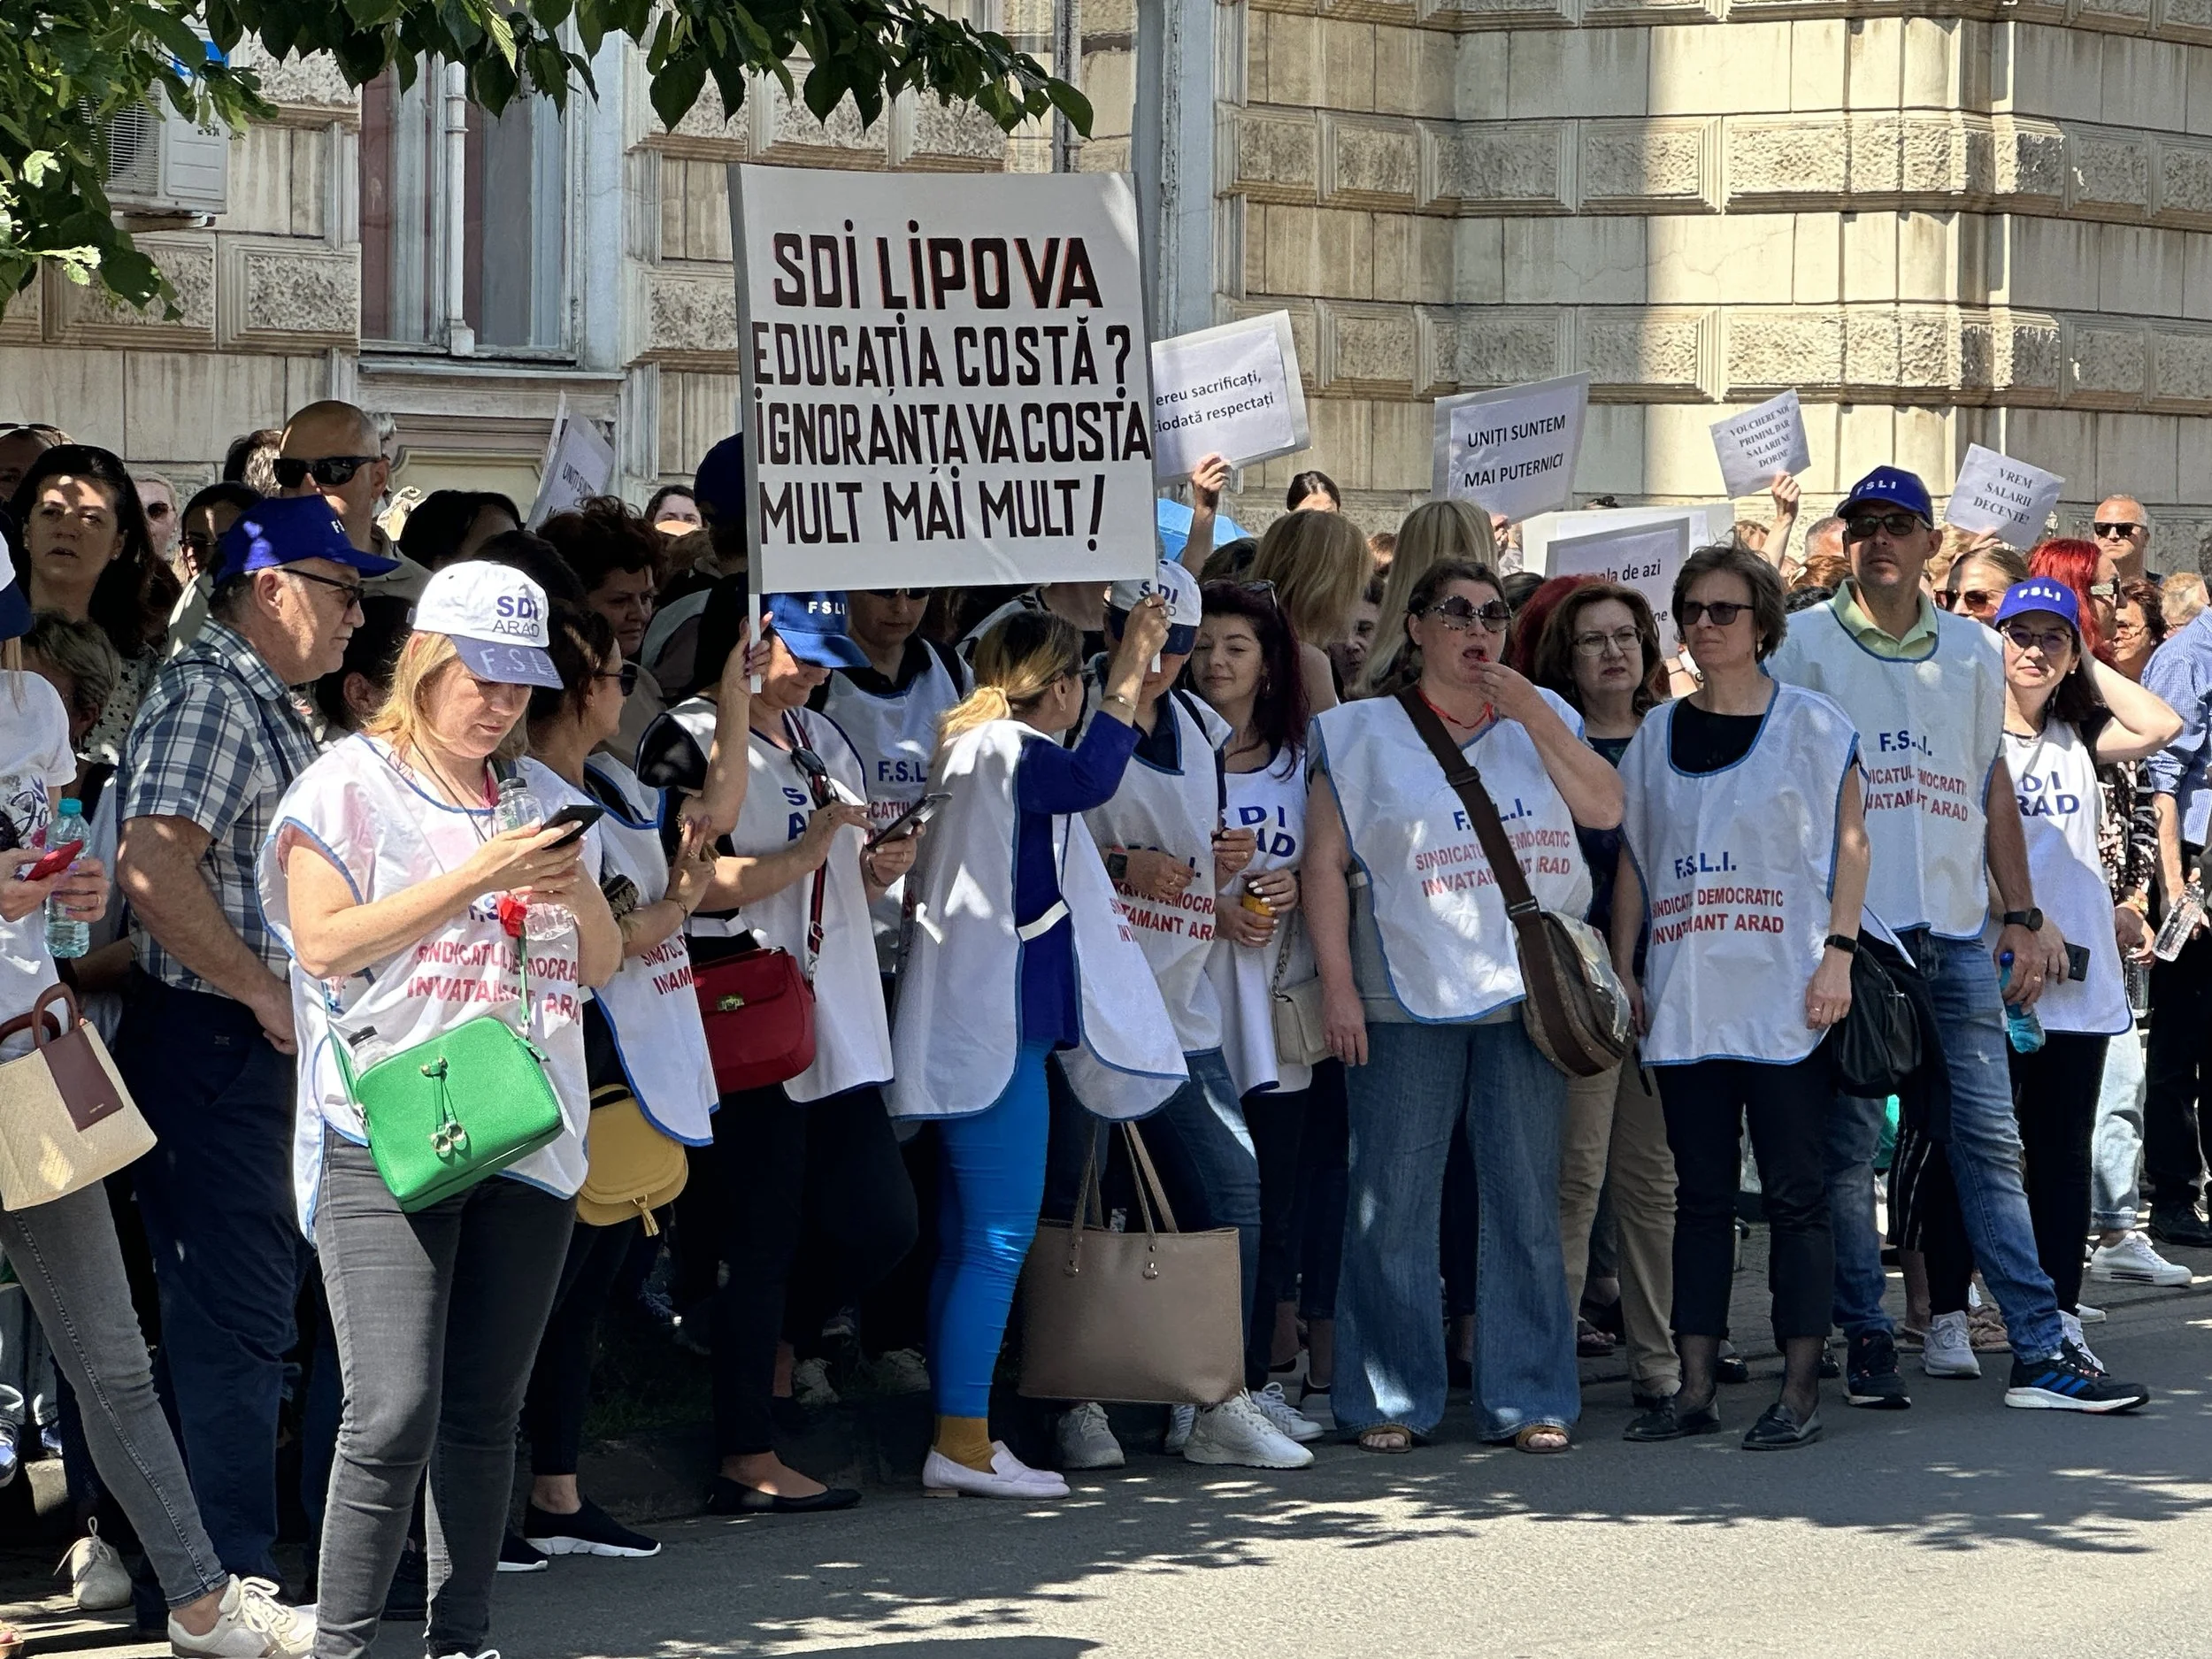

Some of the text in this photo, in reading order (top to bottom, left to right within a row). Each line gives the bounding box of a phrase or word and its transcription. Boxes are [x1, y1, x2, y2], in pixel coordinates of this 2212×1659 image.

[1156, 390, 1187, 407] ereu
[1207, 391, 1274, 421] respectați
[1511, 414, 1566, 441] SUNTEM
[1464, 452, 1564, 488] MAI PUTERNICI
[2000, 467, 2032, 489] VREM
[1985, 482, 2032, 508] SALARII
[759, 480, 863, 545] MULT
[1973, 495, 2030, 526] DECENTE!
[1623, 564, 1639, 581] de
[1642, 558, 1661, 578] azi
[492, 619, 540, 638] ARAD
[1931, 798, 1969, 821] ARAD
[1416, 830, 1571, 872] SINDICATU EMOCRATIC
[1675, 851, 1737, 879] F.S.L.I.
[1697, 887, 1785, 908] DEMOCRATIC
[1734, 914, 1785, 934] ARAD
